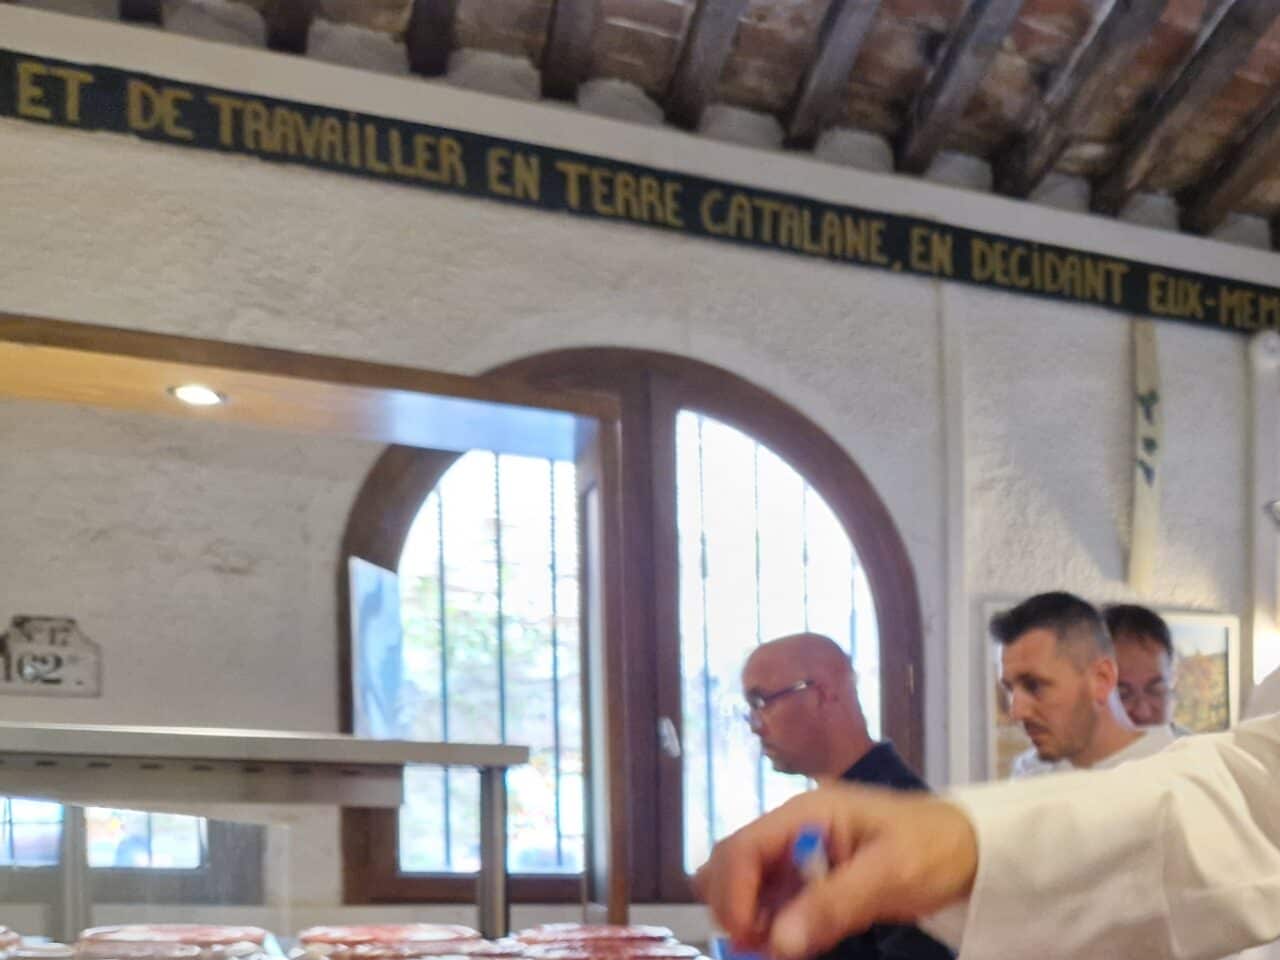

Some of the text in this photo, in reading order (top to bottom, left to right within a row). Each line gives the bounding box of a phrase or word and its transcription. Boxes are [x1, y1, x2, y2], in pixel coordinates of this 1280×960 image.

[18, 61, 94, 122] ET
[128, 80, 194, 140] DE
[487, 149, 541, 201] EN
[555, 161, 687, 228] TERRE
[908, 226, 953, 276] EN
